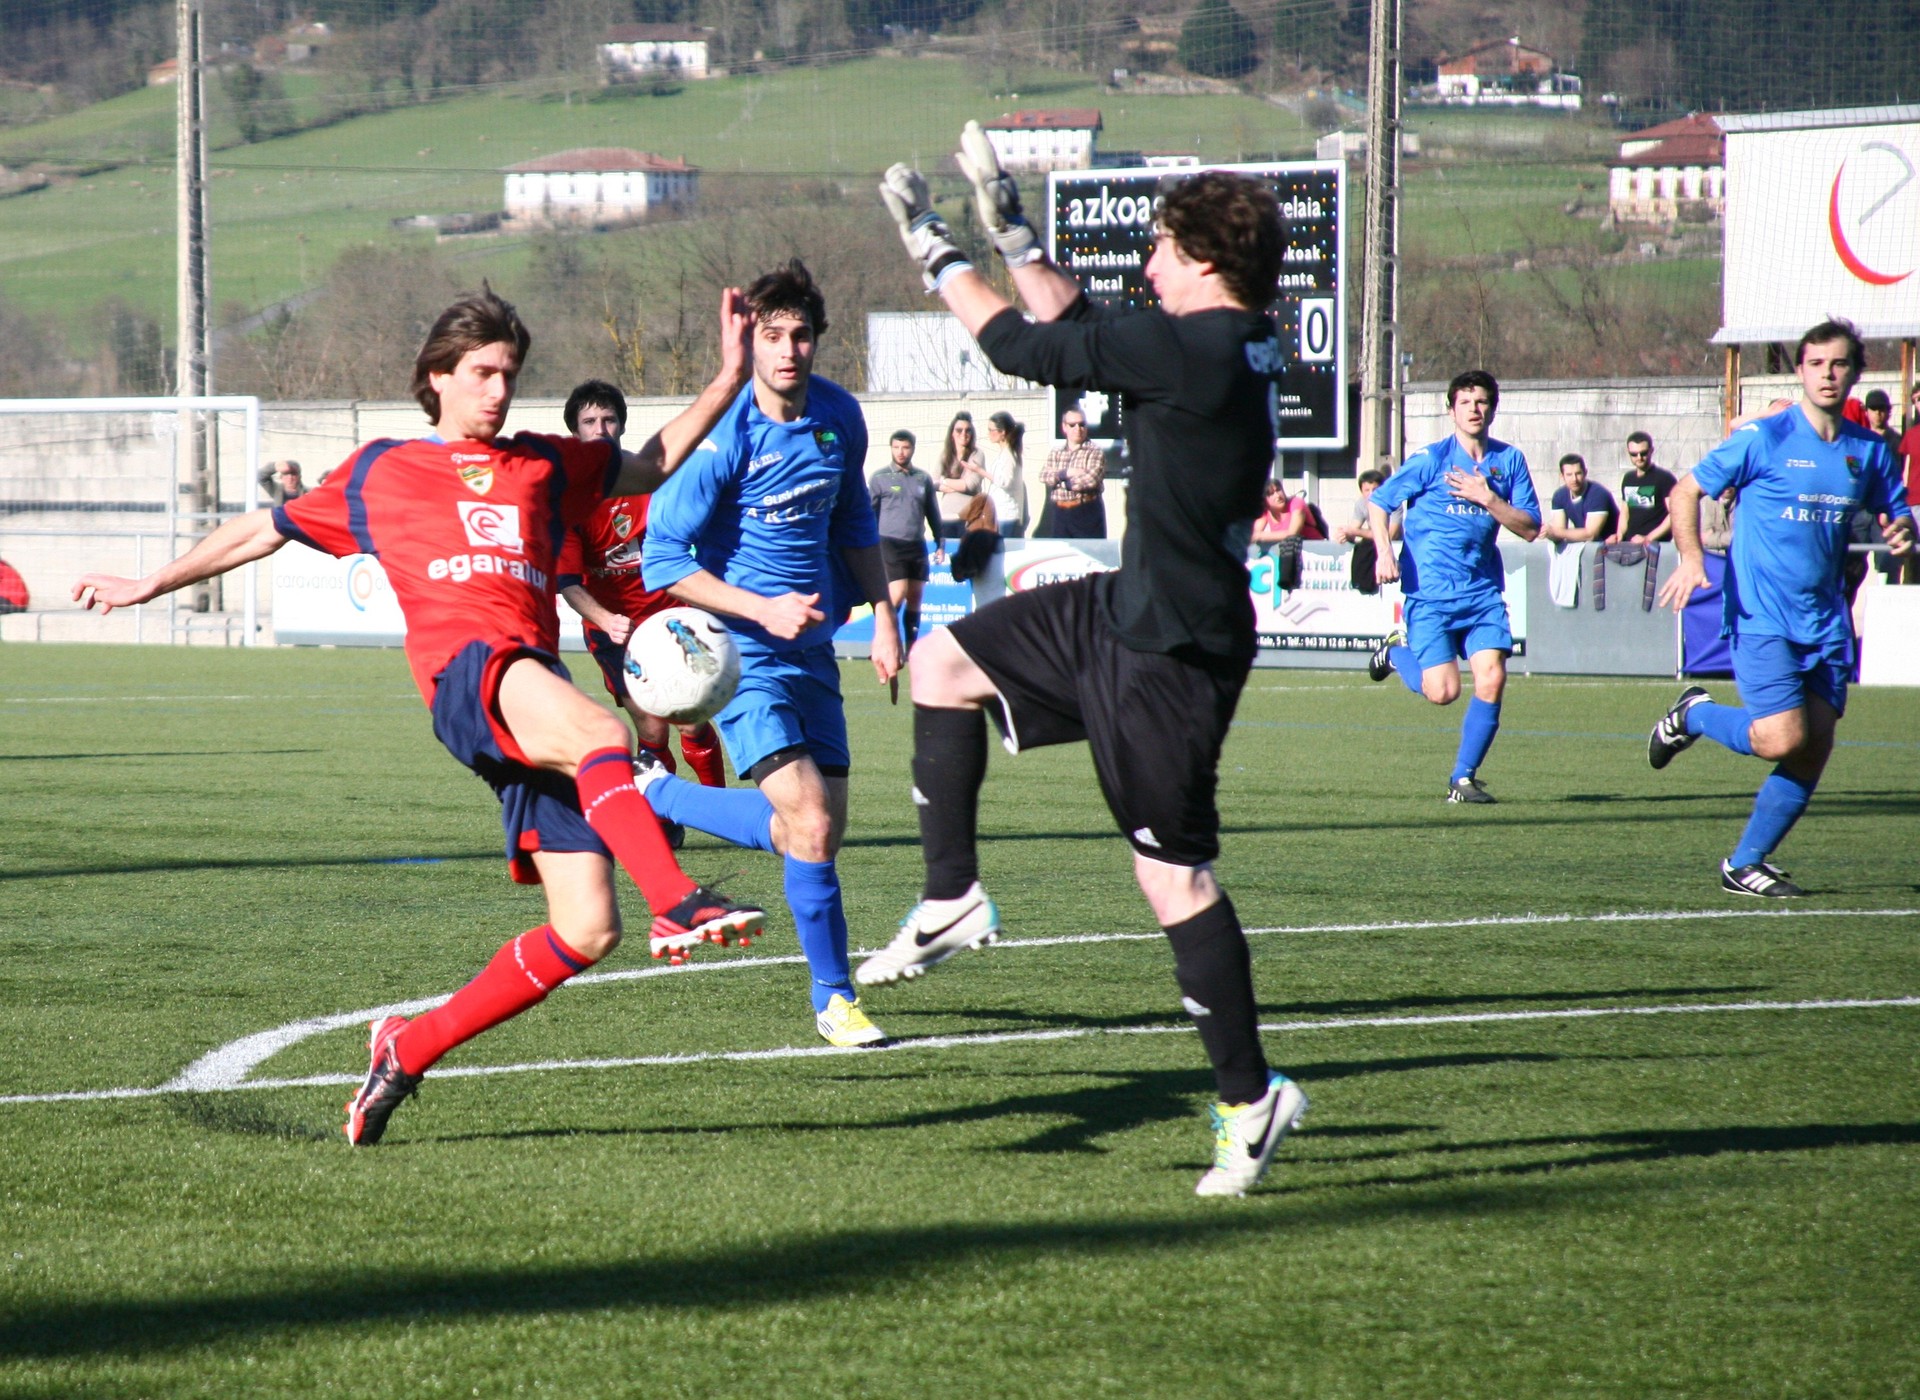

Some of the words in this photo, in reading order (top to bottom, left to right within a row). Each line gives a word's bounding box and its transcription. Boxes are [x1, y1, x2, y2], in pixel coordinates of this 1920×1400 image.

[1072, 250, 1141, 267] bertakoak
[1091, 275, 1123, 291] local
[1306, 307, 1329, 354] 0
[275, 574, 343, 590] caravanas
